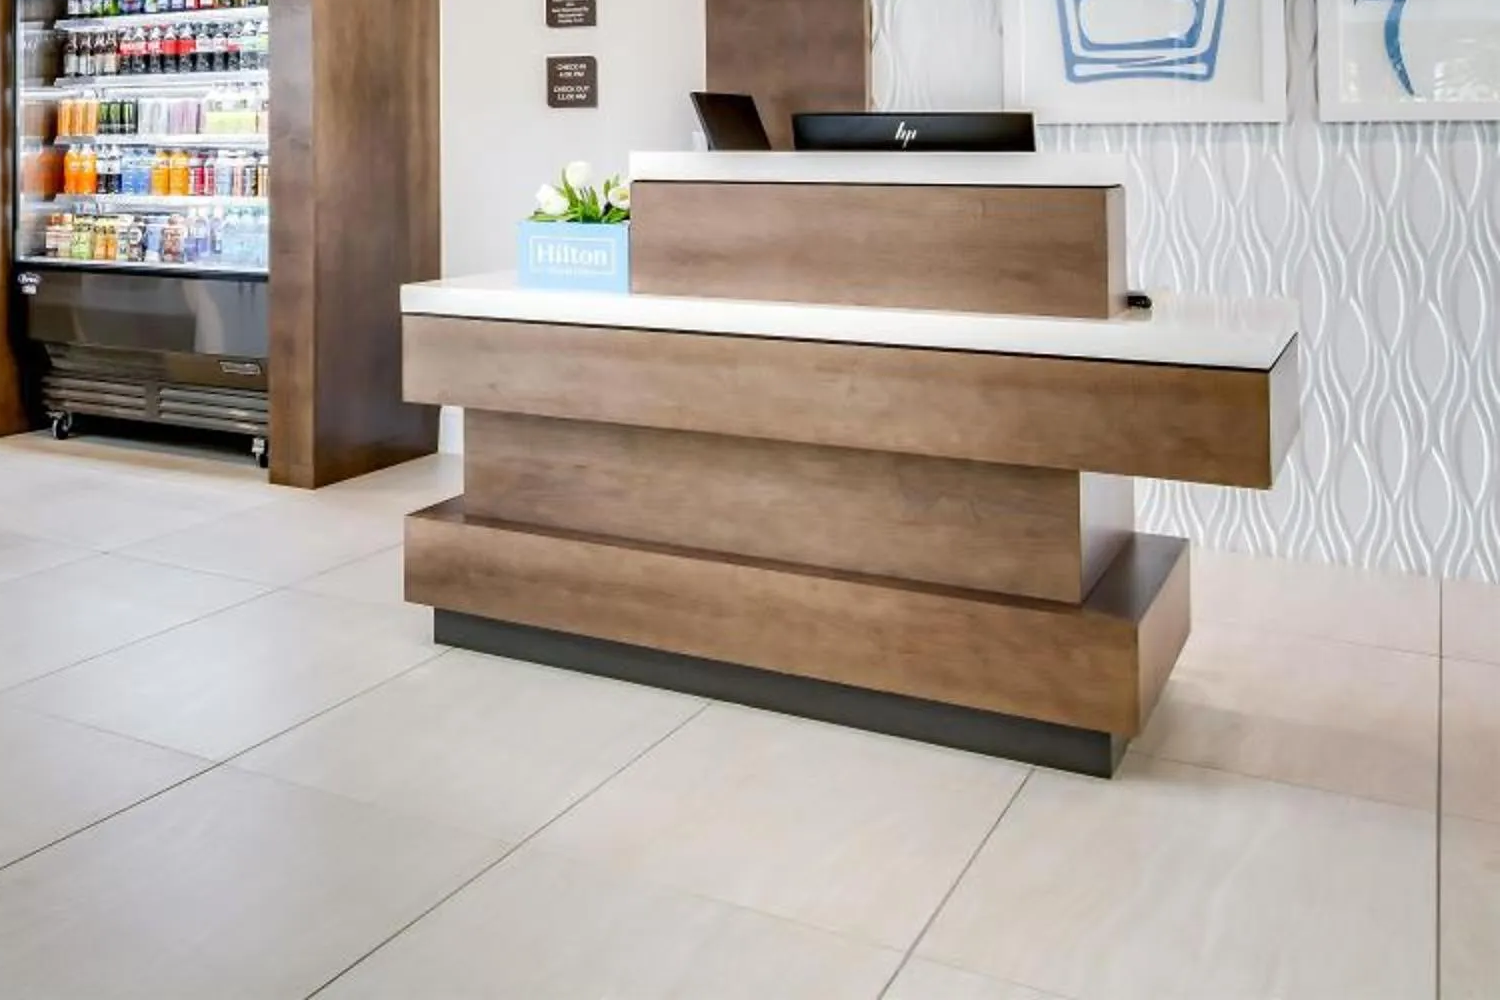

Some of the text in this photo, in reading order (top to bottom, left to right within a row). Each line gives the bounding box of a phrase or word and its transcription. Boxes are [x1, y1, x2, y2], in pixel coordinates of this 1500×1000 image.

[553, 84, 590, 93] CHECK OUT
[895, 121, 917, 149] hp
[536, 243, 608, 267] Hilton
